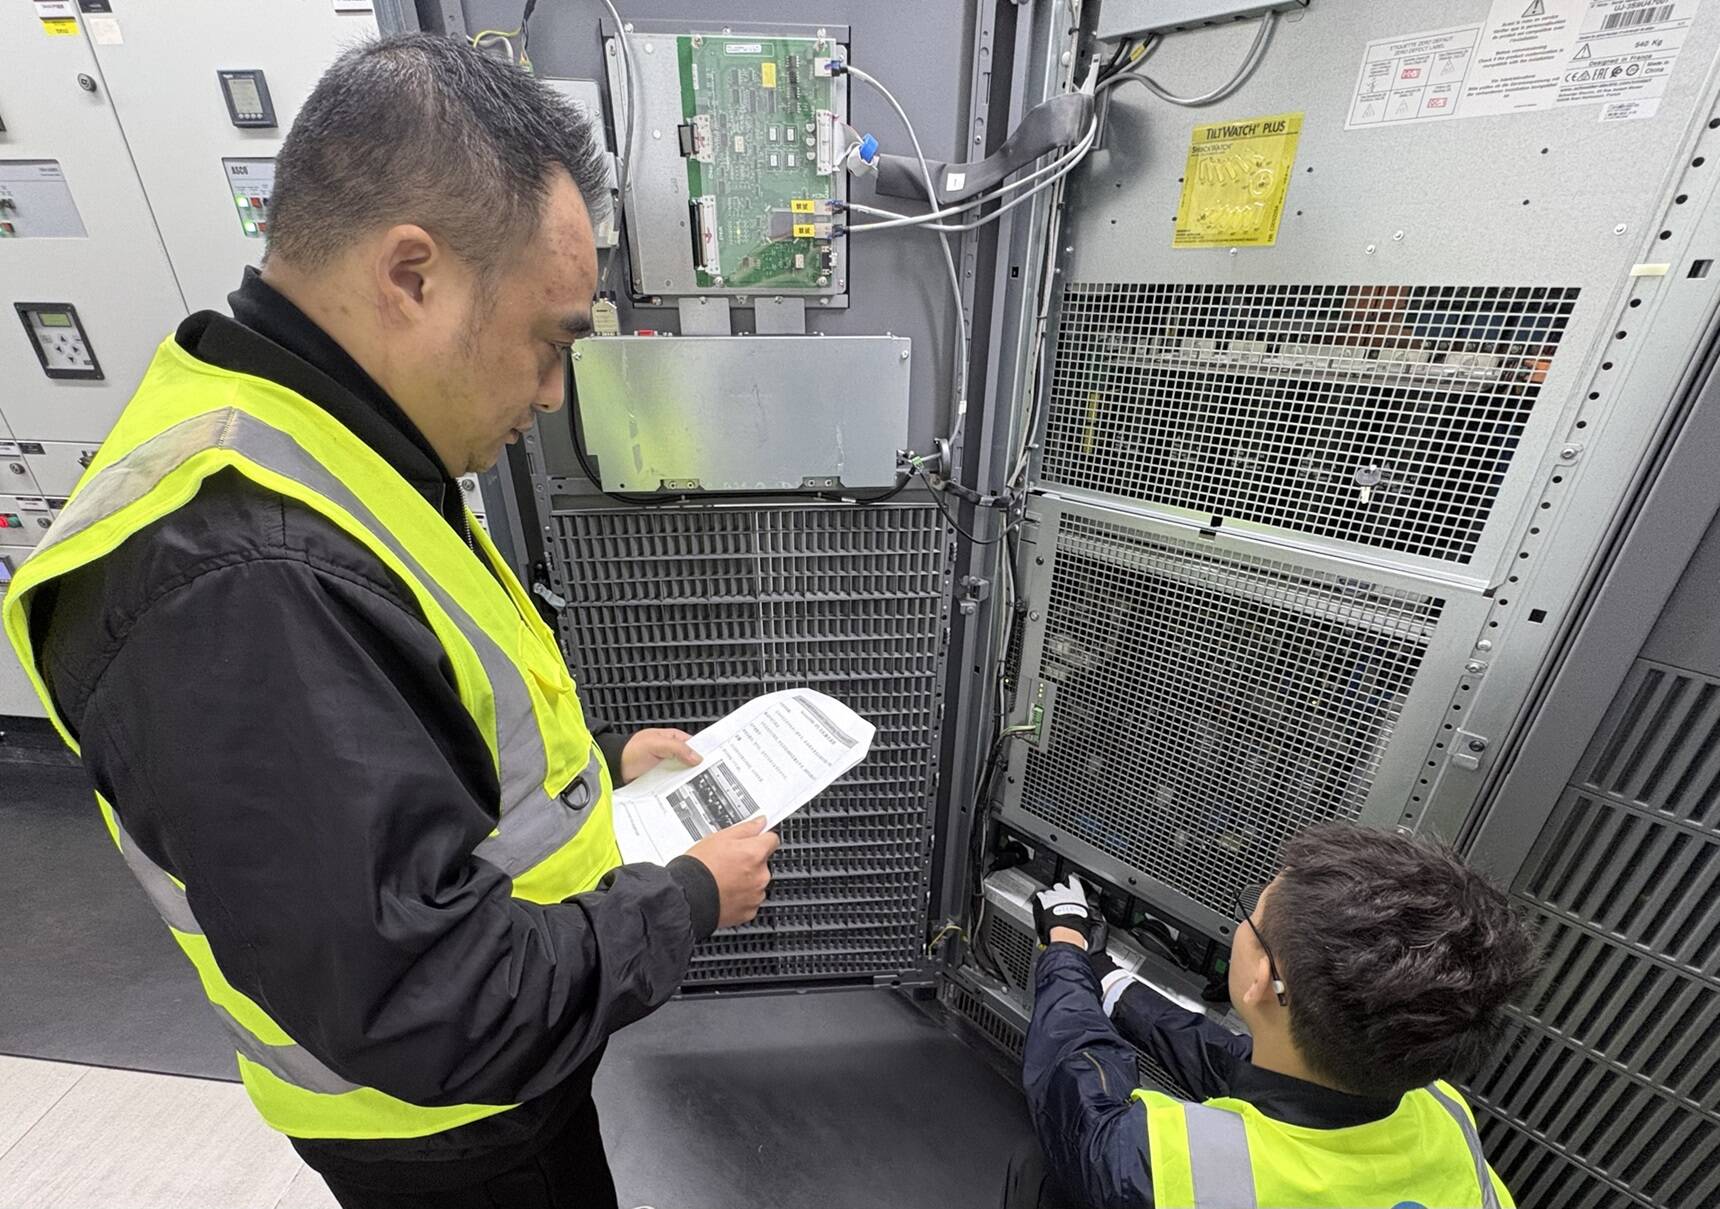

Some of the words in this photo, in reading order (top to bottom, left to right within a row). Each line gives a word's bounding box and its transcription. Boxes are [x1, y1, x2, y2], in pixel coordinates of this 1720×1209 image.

[1651, 39, 1663, 47] Kg
[1588, 58, 1619, 67] Designed
[1630, 54, 1653, 62] France
[1644, 66, 1665, 74] China
[1262, 121, 1286, 133] PLUS
